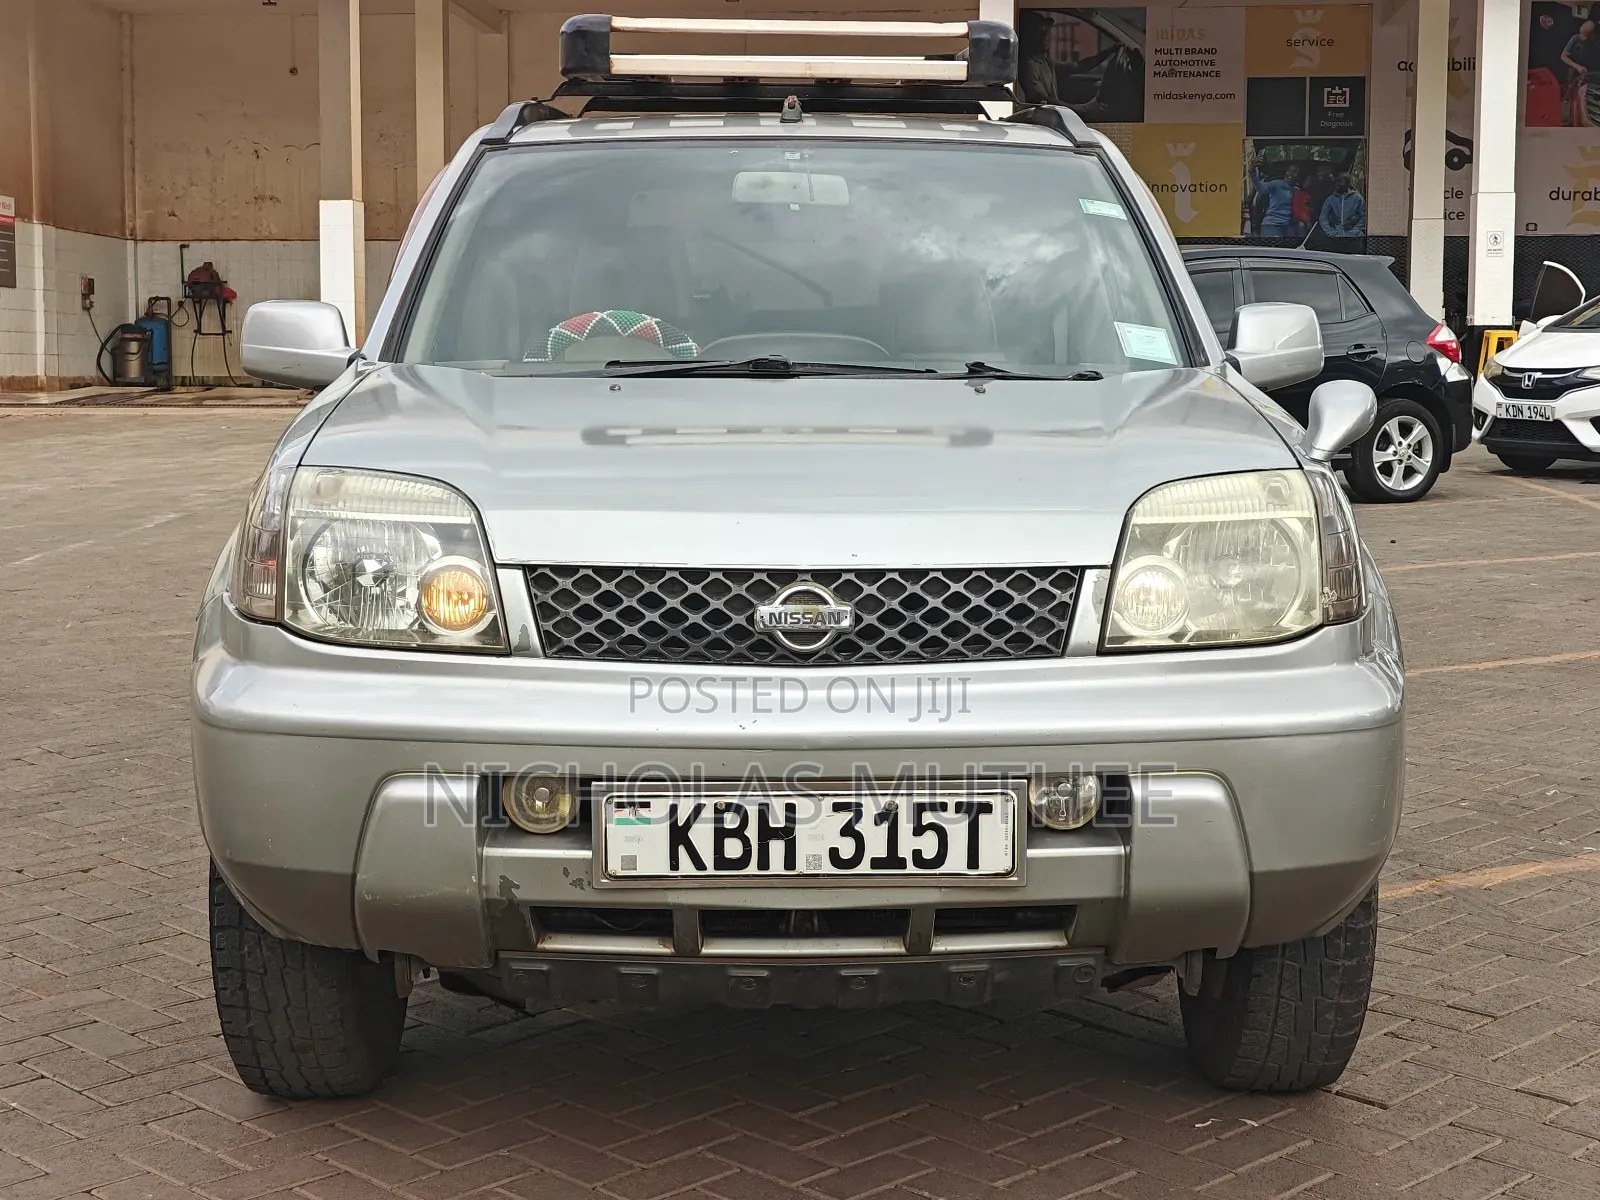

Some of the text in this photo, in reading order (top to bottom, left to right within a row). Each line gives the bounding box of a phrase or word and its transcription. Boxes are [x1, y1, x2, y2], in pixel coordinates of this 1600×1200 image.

[1286, 37, 1335, 47] service
[1154, 59, 1216, 67] AUTOMOTIVE
[1153, 91, 1236, 103] midaskenya.com
[1320, 120, 1354, 128] Diagnosis
[1147, 181, 1228, 193] innovation
[1505, 405, 1551, 420] KDN 194L
[768, 611, 841, 625] NISSAN
[669, 802, 797, 871] KBH
[827, 801, 994, 870] 315T
